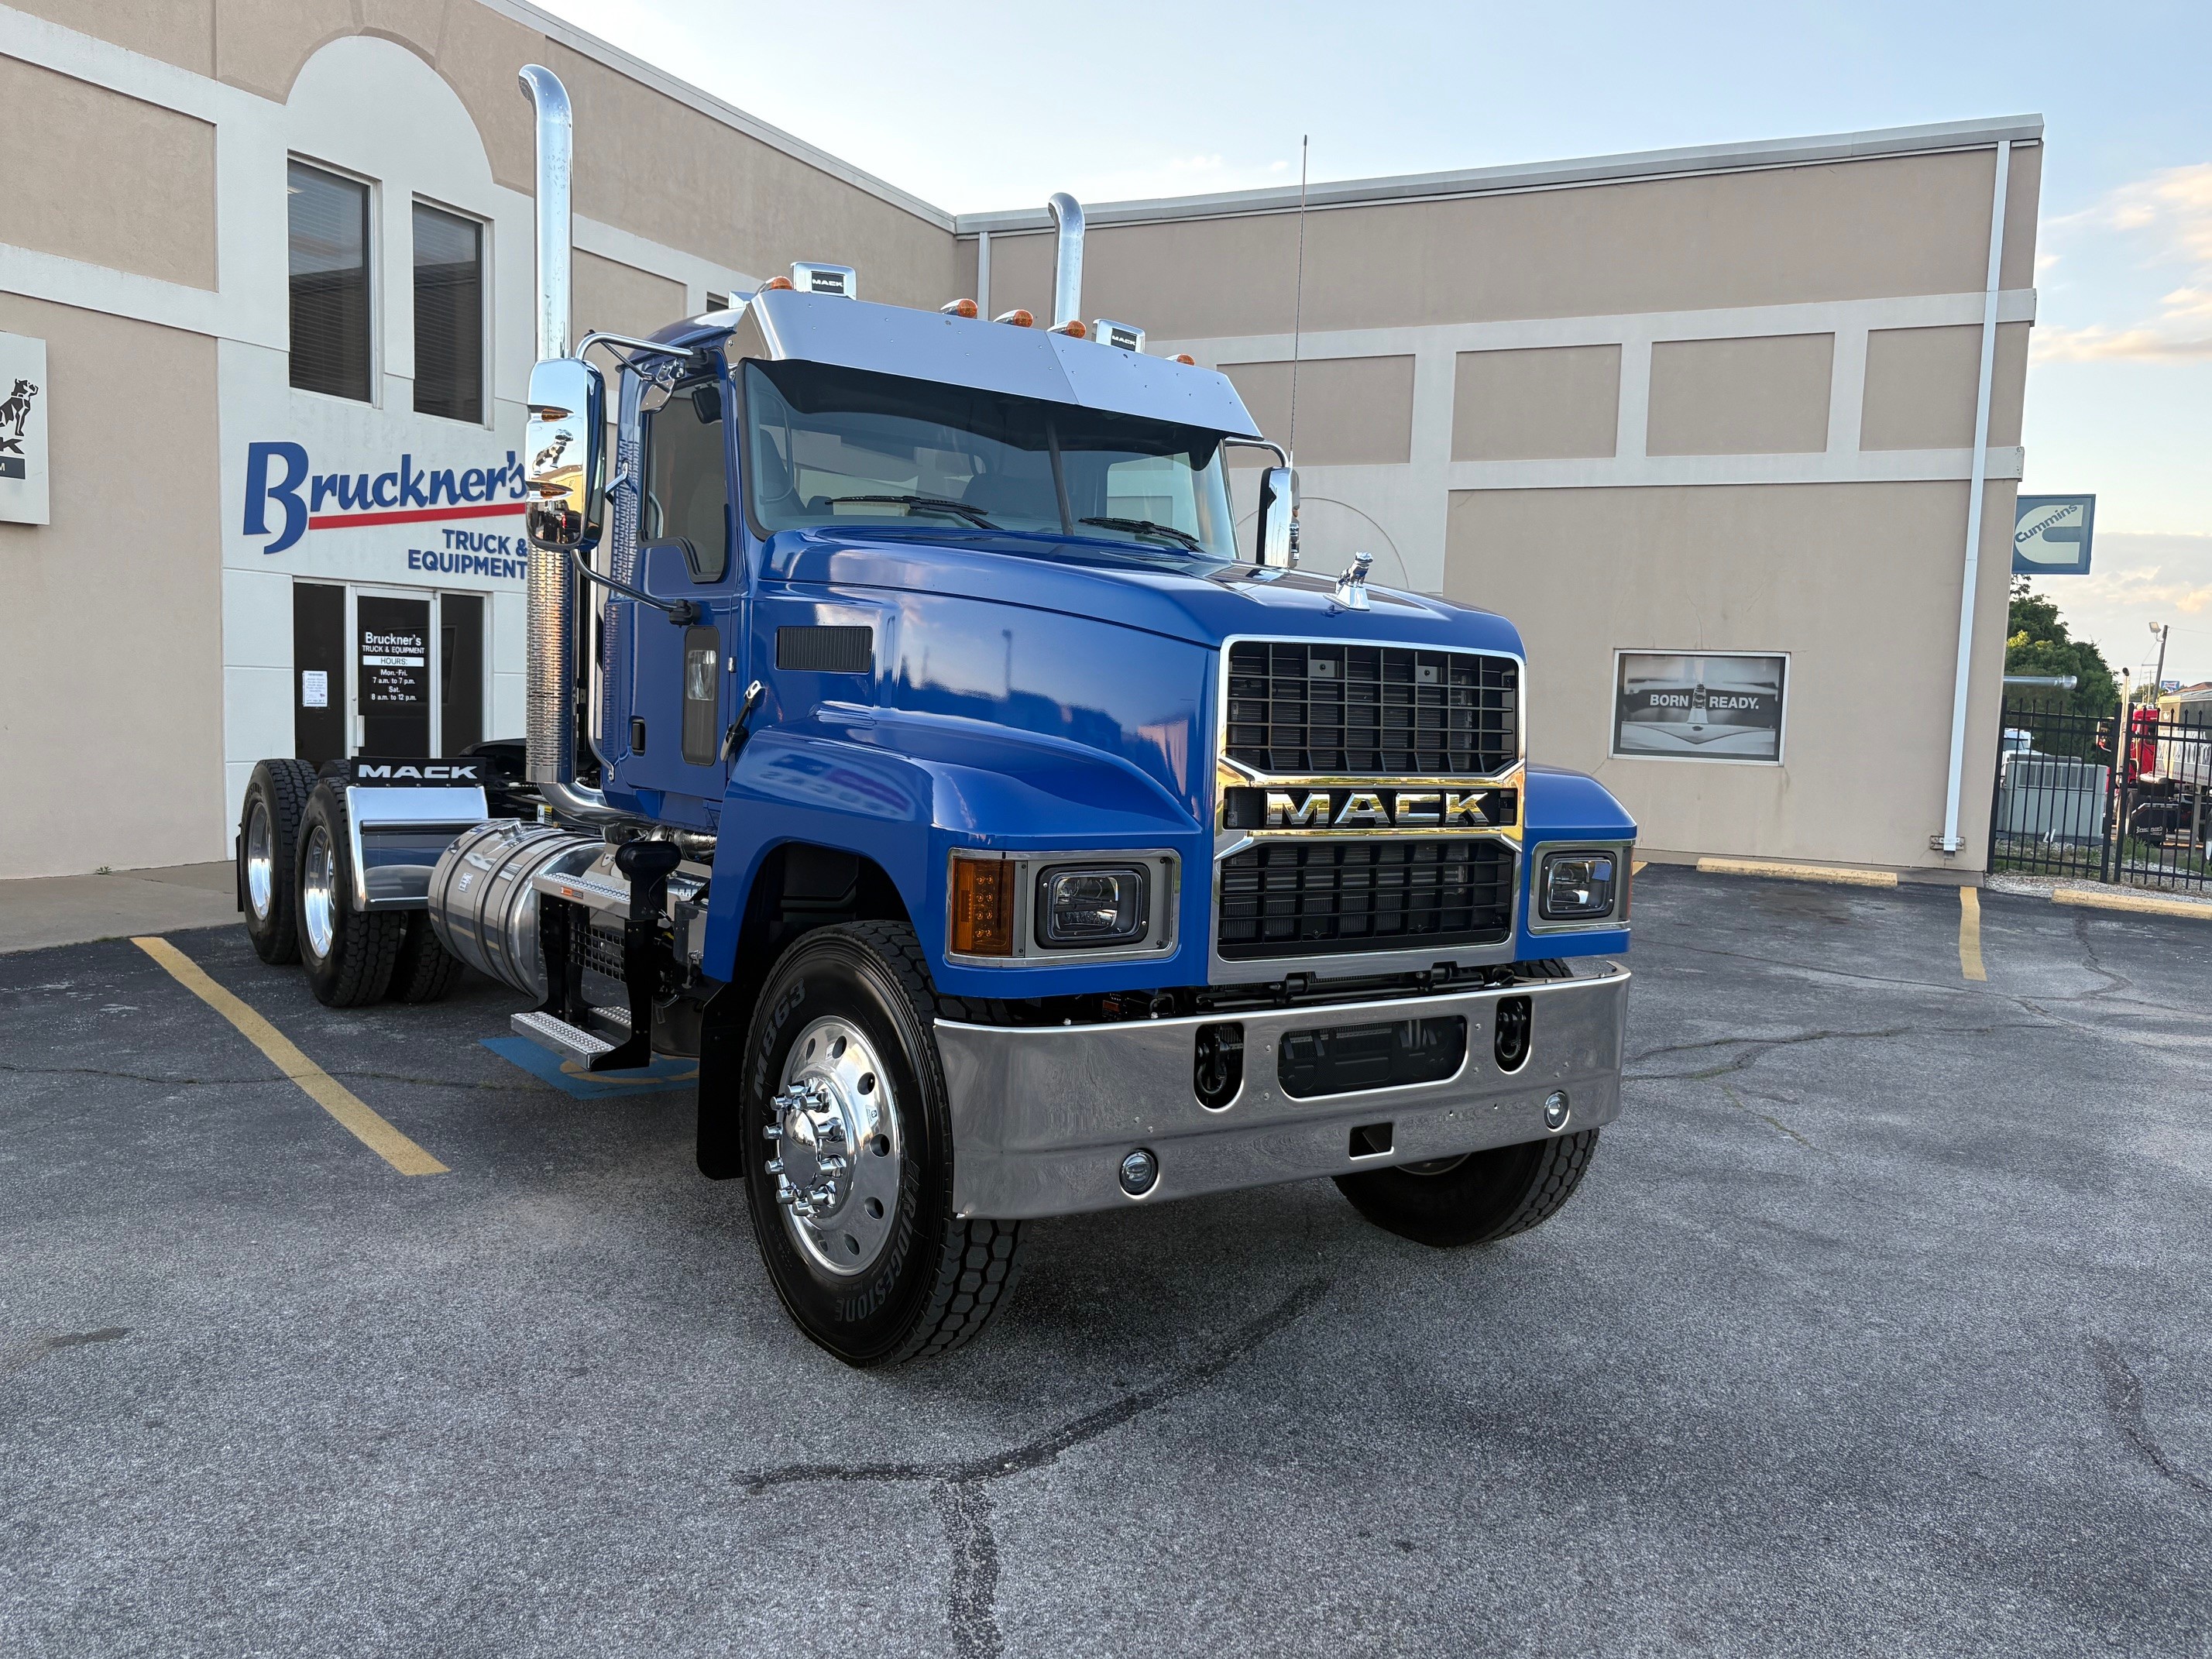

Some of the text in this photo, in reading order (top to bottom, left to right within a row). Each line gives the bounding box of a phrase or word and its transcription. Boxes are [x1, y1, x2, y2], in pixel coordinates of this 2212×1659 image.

[812, 279, 843, 287] MACK
[1111, 335, 1136, 346] MACK
[242, 441, 527, 555] Bruckner's
[2014, 503, 2078, 543] Cummins
[442, 529, 528, 558] TRUCK &
[408, 549, 527, 579] EQUIPMENT
[366, 631, 421, 646] Bruckner's
[391, 646, 425, 654] EQUIPMENT
[380, 657, 408, 665] HOURS:
[1650, 694, 1759, 709] BORN READY.
[358, 764, 479, 779] MACK
[1266, 790, 1489, 826] MACK
[754, 977, 806, 1101] M863
